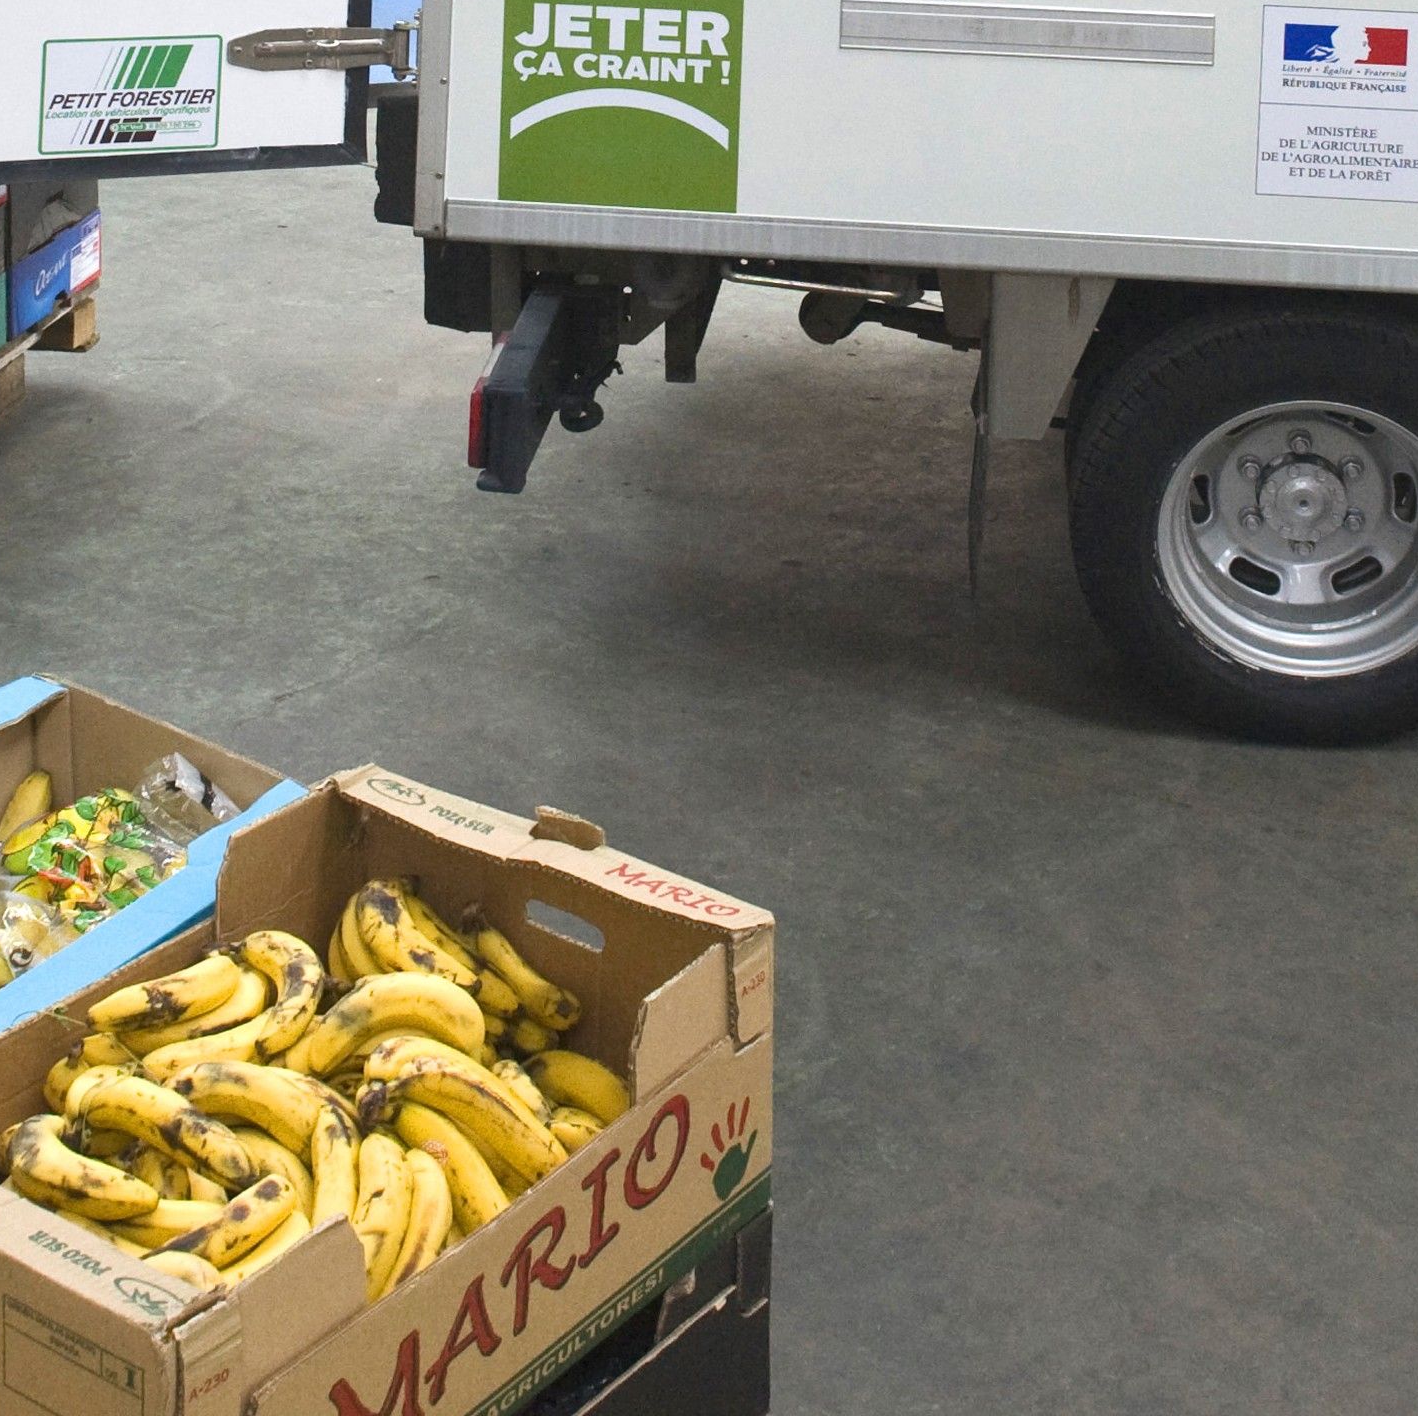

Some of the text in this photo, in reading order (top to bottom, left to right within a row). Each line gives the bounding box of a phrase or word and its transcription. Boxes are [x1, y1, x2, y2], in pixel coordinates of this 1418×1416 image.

[514, 2, 730, 56] JETER
[513, 50, 564, 82] ÇA
[573, 53, 712, 84] CRAINT
[1282, 64, 1311, 73] Liberté
[49, 89, 216, 110] PETIT FORESTIER
[1282, 78, 1407, 93] RÉPUBLIQUE FRANÇAISE
[45, 109, 88, 120] Location
[90, 108, 102, 117] de
[104, 106, 150, 117] véhicules
[1279, 138, 1404, 154] DE L'AGRICULTURE
[1307, 125, 1378, 139] MINISTÈRE
[1261, 152, 1279, 162] DE
[1288, 167, 1392, 182] ET DE LA FORÊT
[429, 804, 495, 837] POZO SUR
[604, 862, 741, 918] MARIO
[741, 970, 767, 999] A-230
[28, 1230, 113, 1277] POZO SUR
[328, 1093, 691, 1416] MARIO
[485, 1266, 665, 1416] AGRICULTORES!
[188, 1368, 230, 1403] A-230
